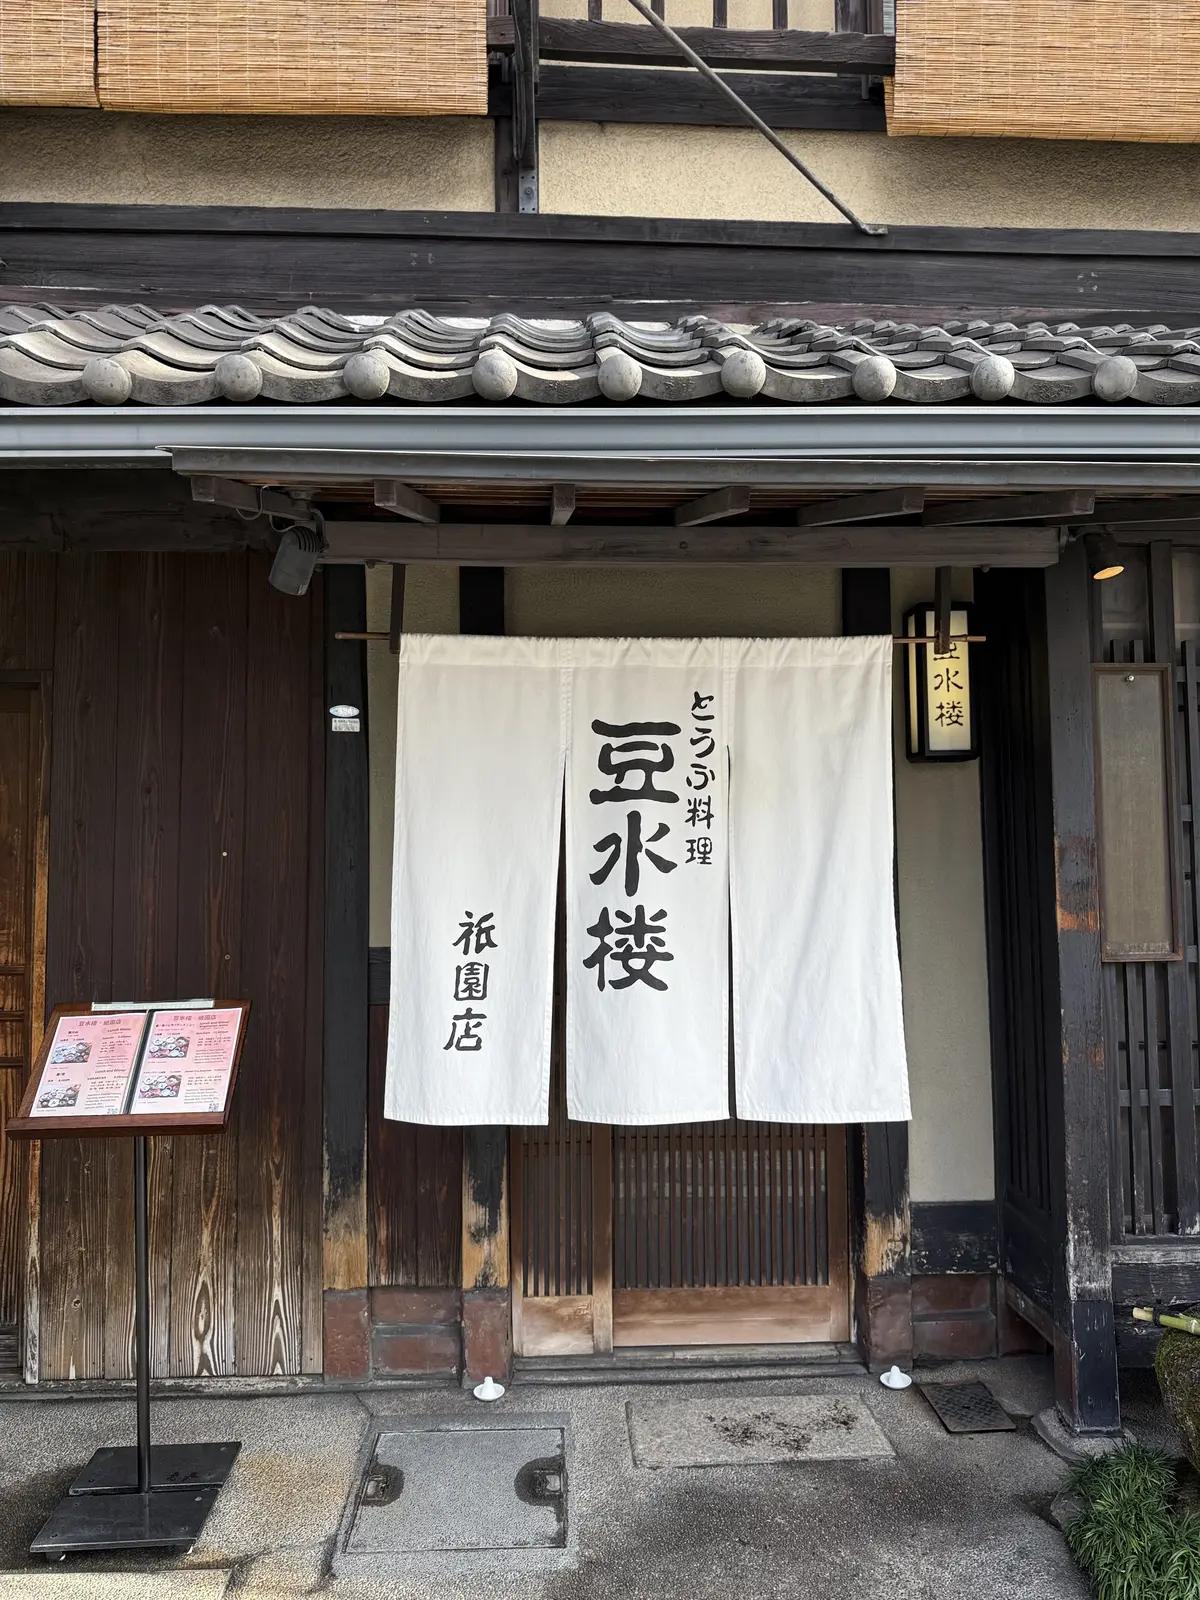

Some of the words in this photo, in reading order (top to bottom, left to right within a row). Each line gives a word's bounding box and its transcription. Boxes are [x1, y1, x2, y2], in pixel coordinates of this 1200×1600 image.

[583, 719, 682, 992] 豆水楼
[684, 690, 716, 865] とうふ料理
[443, 910, 499, 1052] 祇園店
